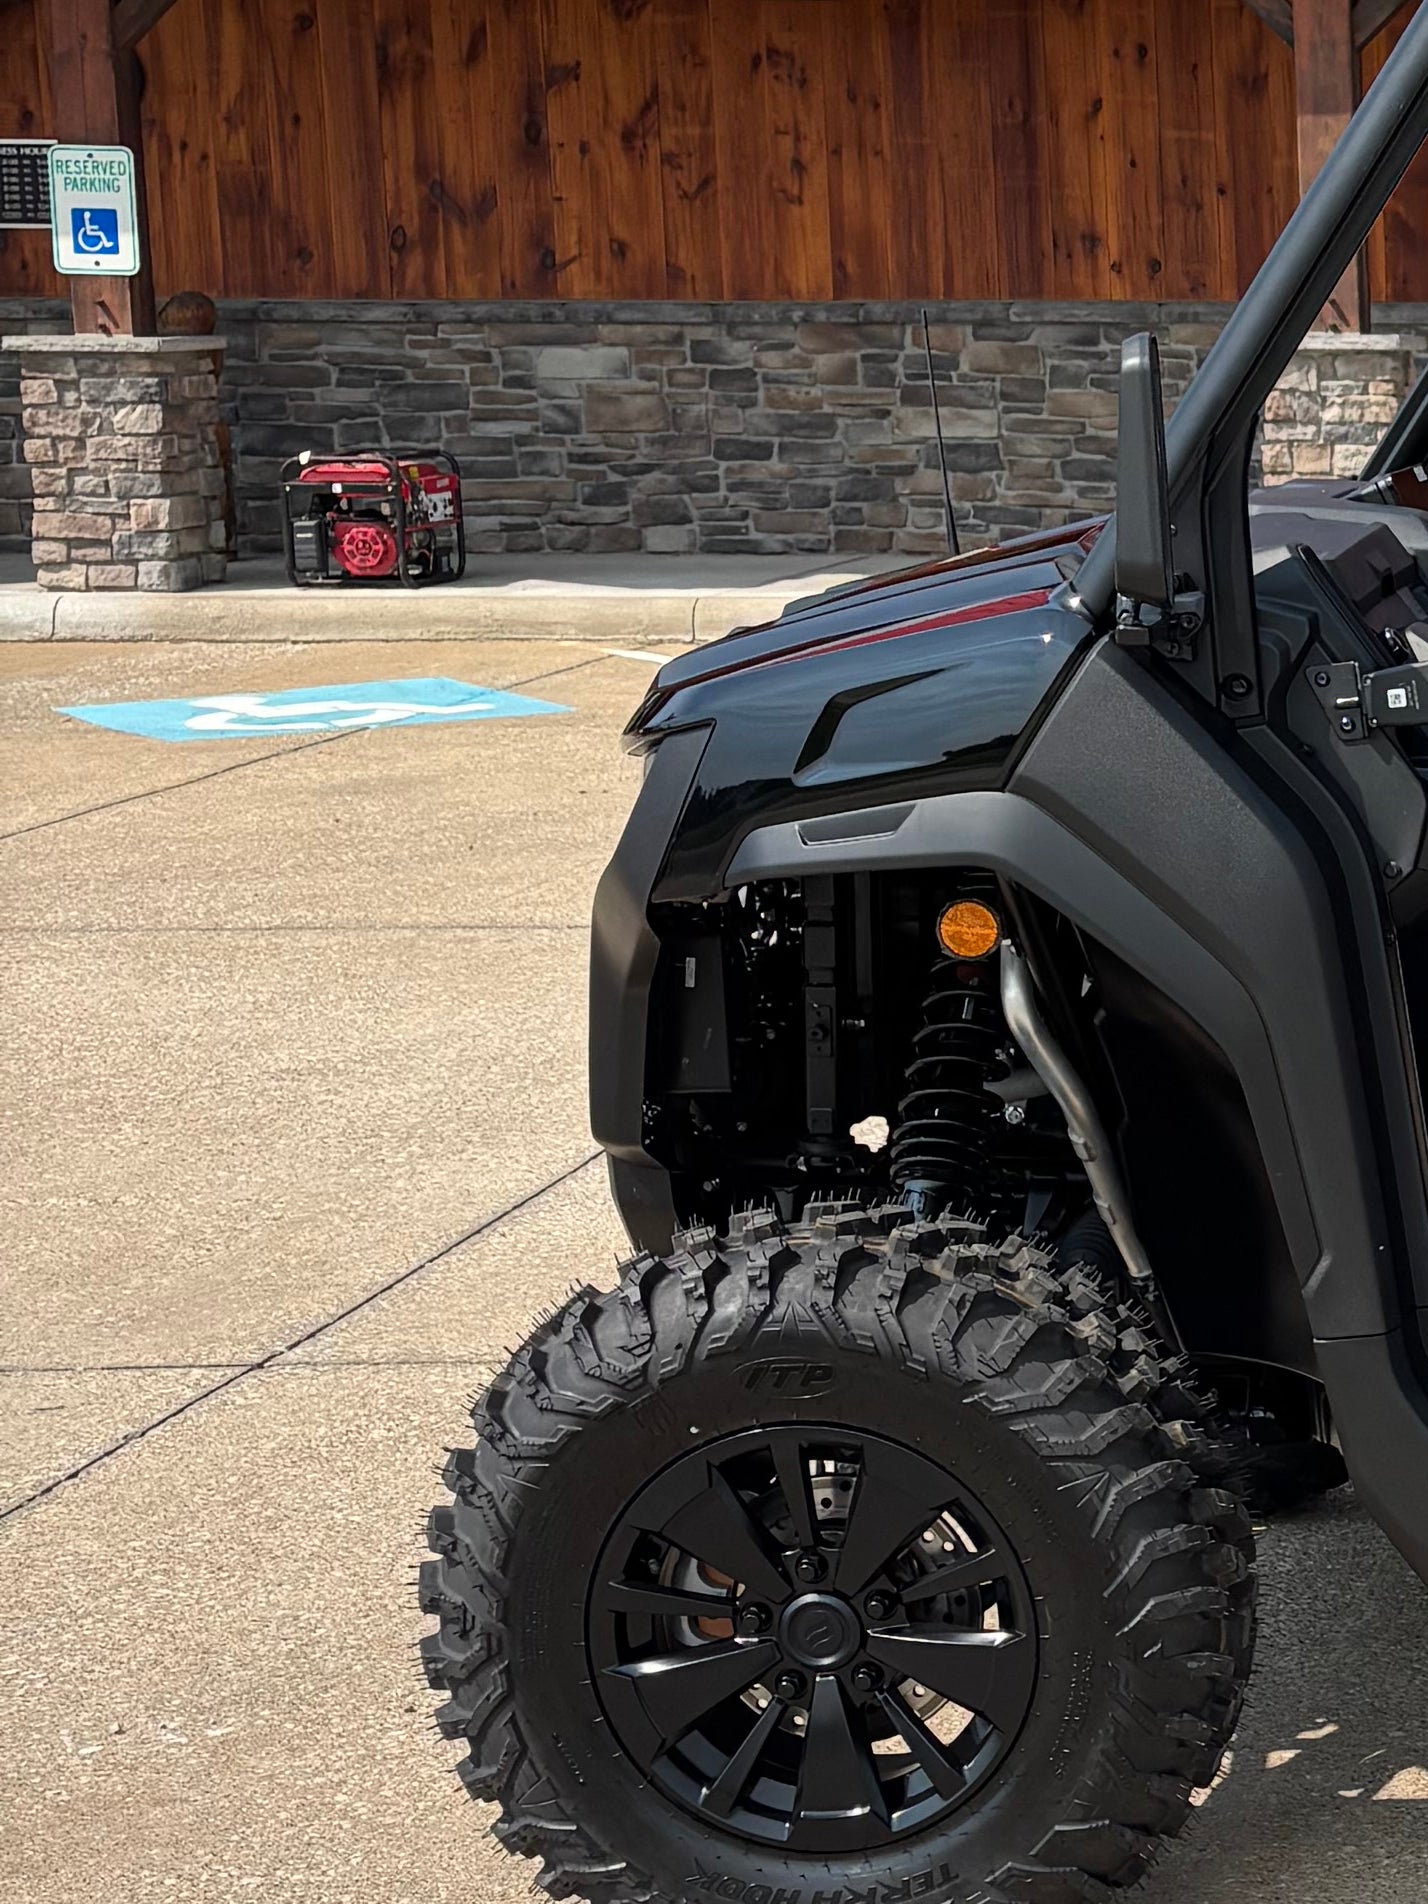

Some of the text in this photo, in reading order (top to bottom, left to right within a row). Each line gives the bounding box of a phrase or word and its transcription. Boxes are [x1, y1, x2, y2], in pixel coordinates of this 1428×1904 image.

[55, 159, 126, 176] RESERVED
[64, 176, 120, 193] PARKING
[745, 1363, 834, 1390] ITP
